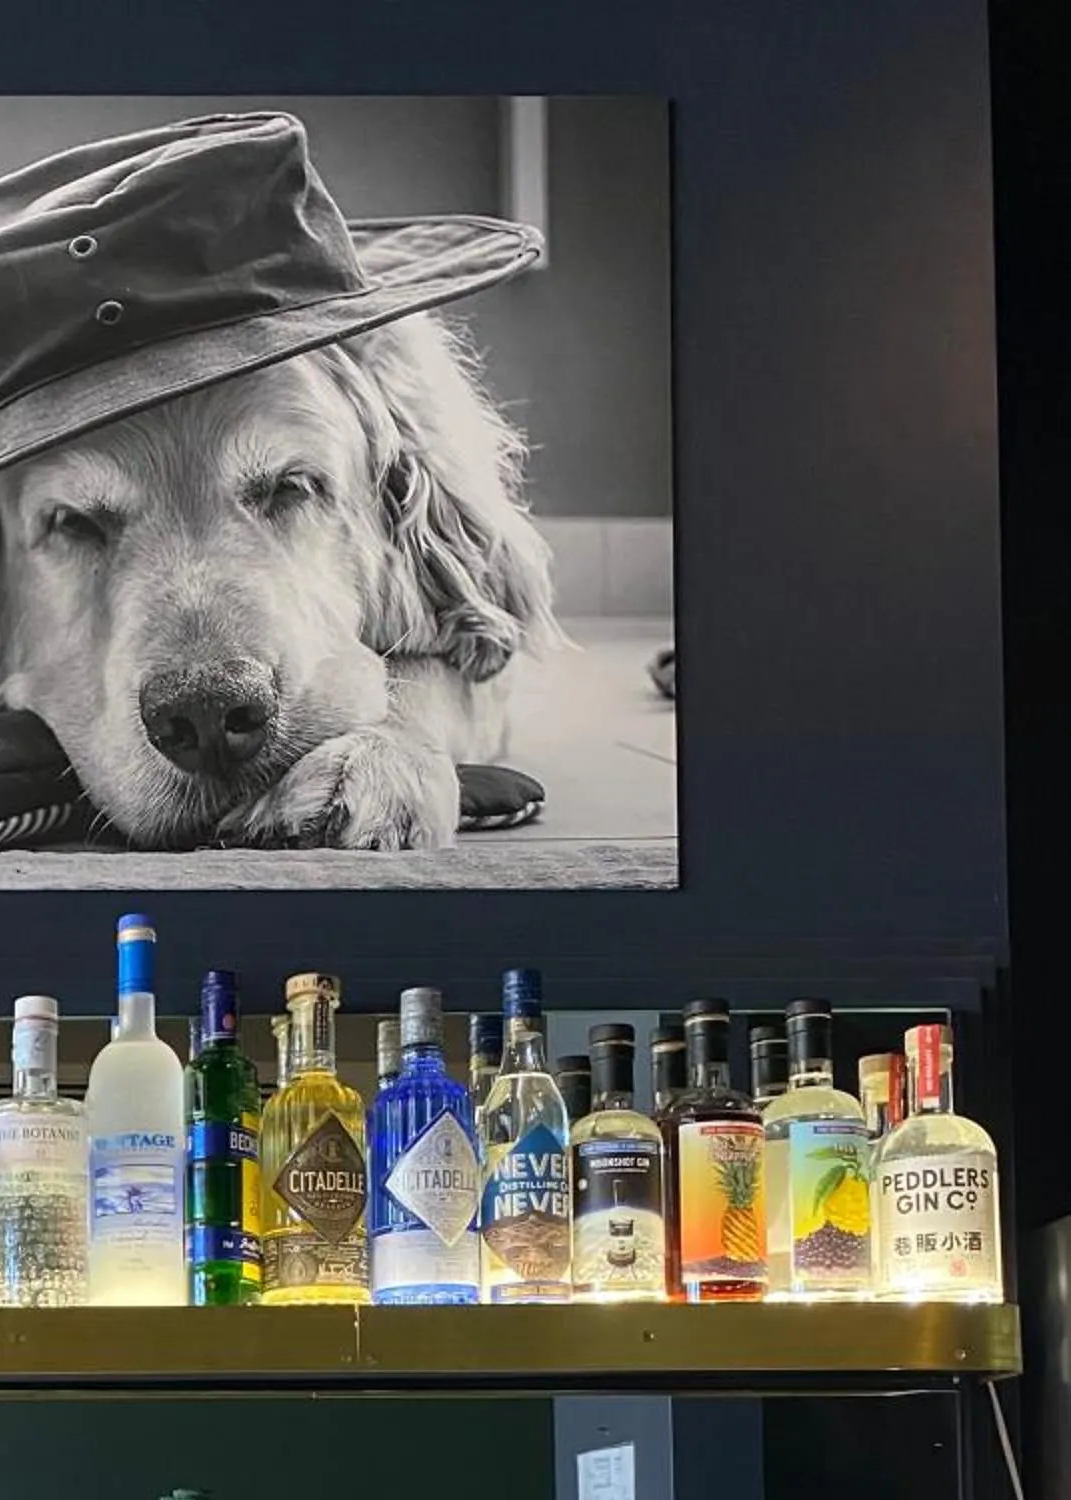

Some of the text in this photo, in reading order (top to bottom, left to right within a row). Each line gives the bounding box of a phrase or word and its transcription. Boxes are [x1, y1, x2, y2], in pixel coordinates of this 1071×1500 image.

[637, 1156, 650, 1168] GIN
[289, 1169, 365, 1194] CITADELLE
[882, 1168, 990, 1195] PEDDLERS
[896, 1192, 939, 1215] GIN
